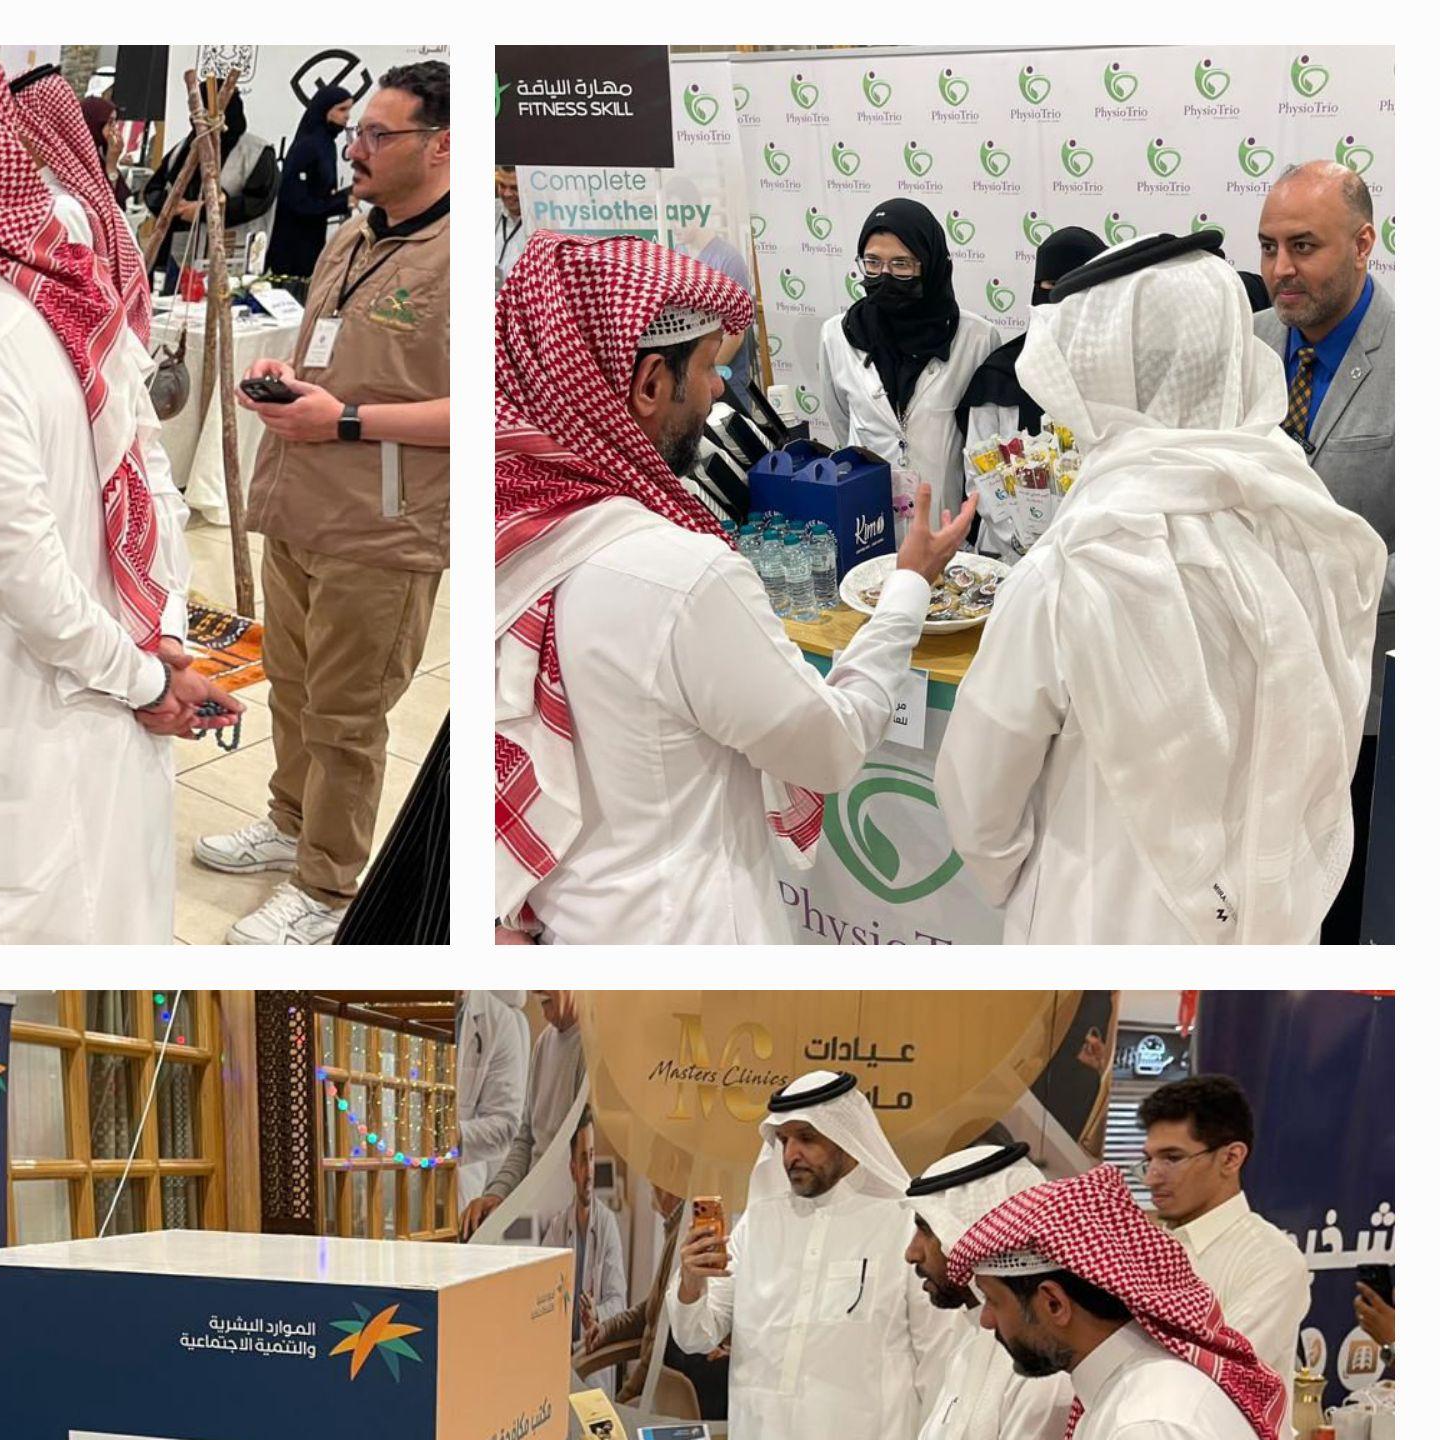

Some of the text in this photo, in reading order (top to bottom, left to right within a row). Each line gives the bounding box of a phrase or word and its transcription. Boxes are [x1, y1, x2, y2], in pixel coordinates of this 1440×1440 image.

[516, 79, 634, 98] مهارة اللياقة
[518, 100, 634, 117] FITNESS SKILL
[1010, 108, 1062, 121] PhysioTrio
[1094, 106, 1148, 120] PhysioTrio
[1183, 104, 1240, 119] PhysioTrio
[1278, 101, 1339, 117] PhysioTrio
[856, 111, 902, 125] PhysioTrio
[931, 110, 980, 124] PhysioTrio
[677, 129, 731, 146] PhysioTrio
[530, 169, 646, 197] Complete
[898, 180, 943, 193] PhysioTrio
[972, 181, 1021, 193] PhysioTrio
[1052, 181, 1104, 194] PhysioTrio
[1136, 181, 1191, 195] PhysioTrio
[804, 1035, 916, 1067] عيادات
[648, 1060, 789, 1088] Masters Clinics
[208, 1314, 316, 1338] الموارد البشرية
[179, 1331, 316, 1359] والتنمية الاجتماعية
[530, 1396, 552, 1436] مكتب
